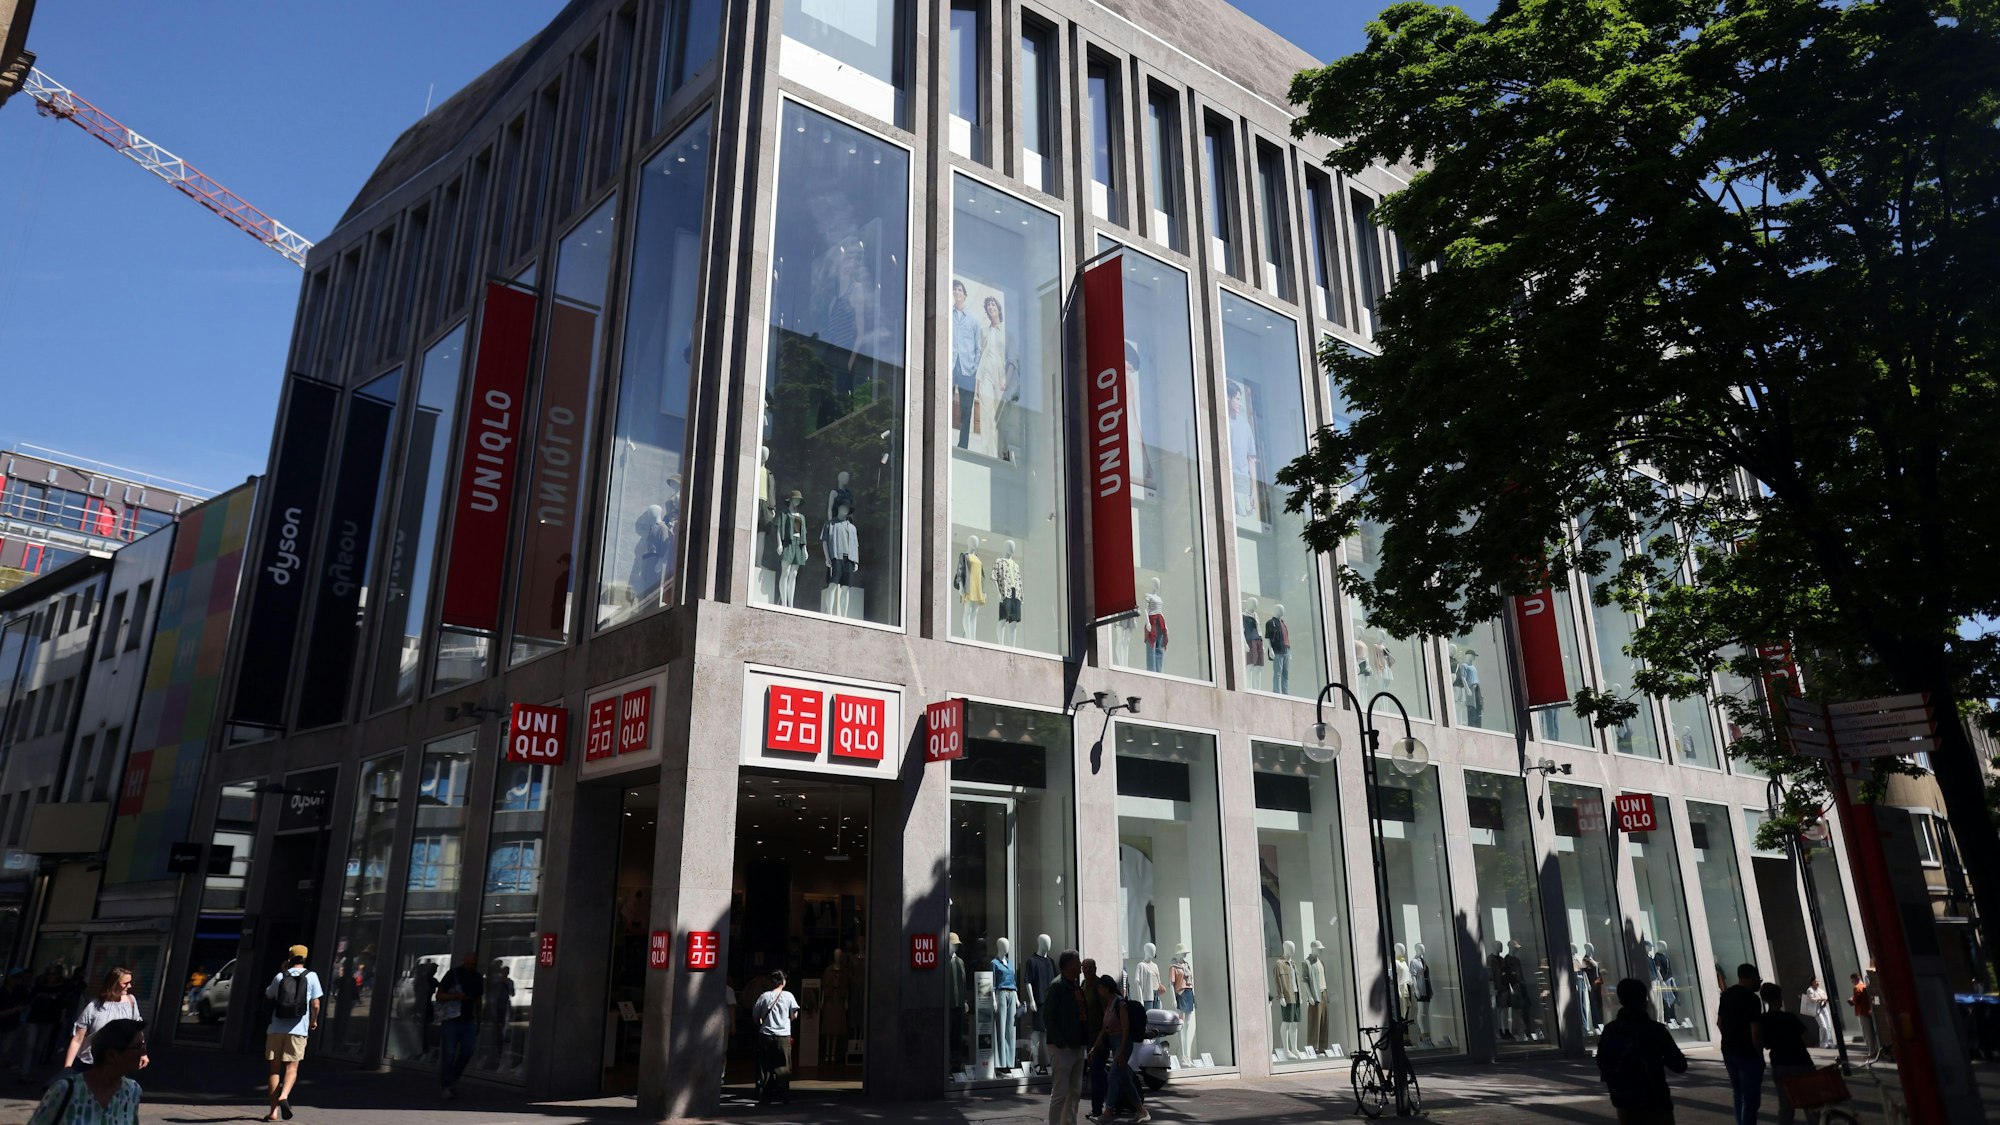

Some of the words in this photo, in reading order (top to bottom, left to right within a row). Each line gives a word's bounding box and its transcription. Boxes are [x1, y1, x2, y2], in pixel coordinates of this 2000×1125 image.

[1097, 367, 1123, 498] UNIQLO
[470, 389, 512, 513] UNIQLO
[267, 506, 303, 586] dyson
[624, 695, 646, 721] UNI
[777, 694, 816, 718] ユニ
[840, 701, 876, 727] UNI
[930, 706, 957, 731] UNI
[517, 710, 558, 734] UNI
[621, 720, 645, 749] QLO
[515, 734, 559, 758] QLO
[839, 727, 879, 752] QLO
[929, 731, 959, 757] QLO
[127, 768, 145, 798] HI
[1620, 798, 1647, 812] UNI
[1623, 813, 1652, 829] QLO
[652, 936, 667, 949] UNI
[915, 938, 933, 950] UNI
[651, 950, 666, 964] QLO
[915, 951, 935, 965] QLO
